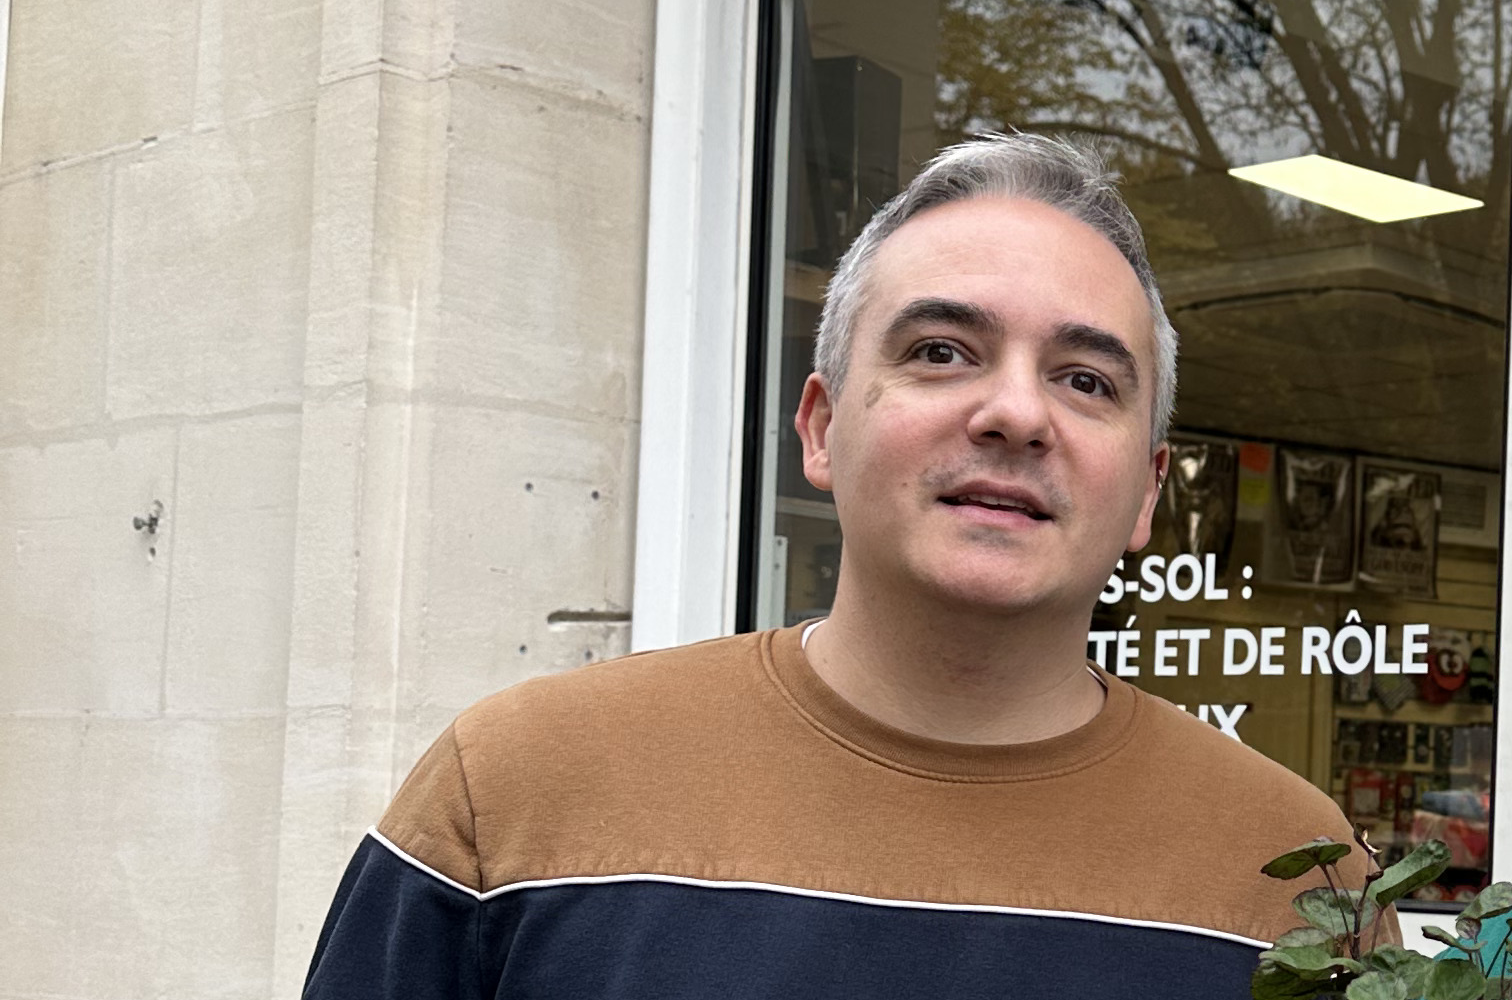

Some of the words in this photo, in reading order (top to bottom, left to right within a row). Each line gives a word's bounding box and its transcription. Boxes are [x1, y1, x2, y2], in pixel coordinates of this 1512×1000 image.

[1088, 615, 1140, 677] TÉ
[1154, 629, 1211, 676] ET
[1223, 627, 1286, 675] DE
[1301, 608, 1430, 675] RÔLE
